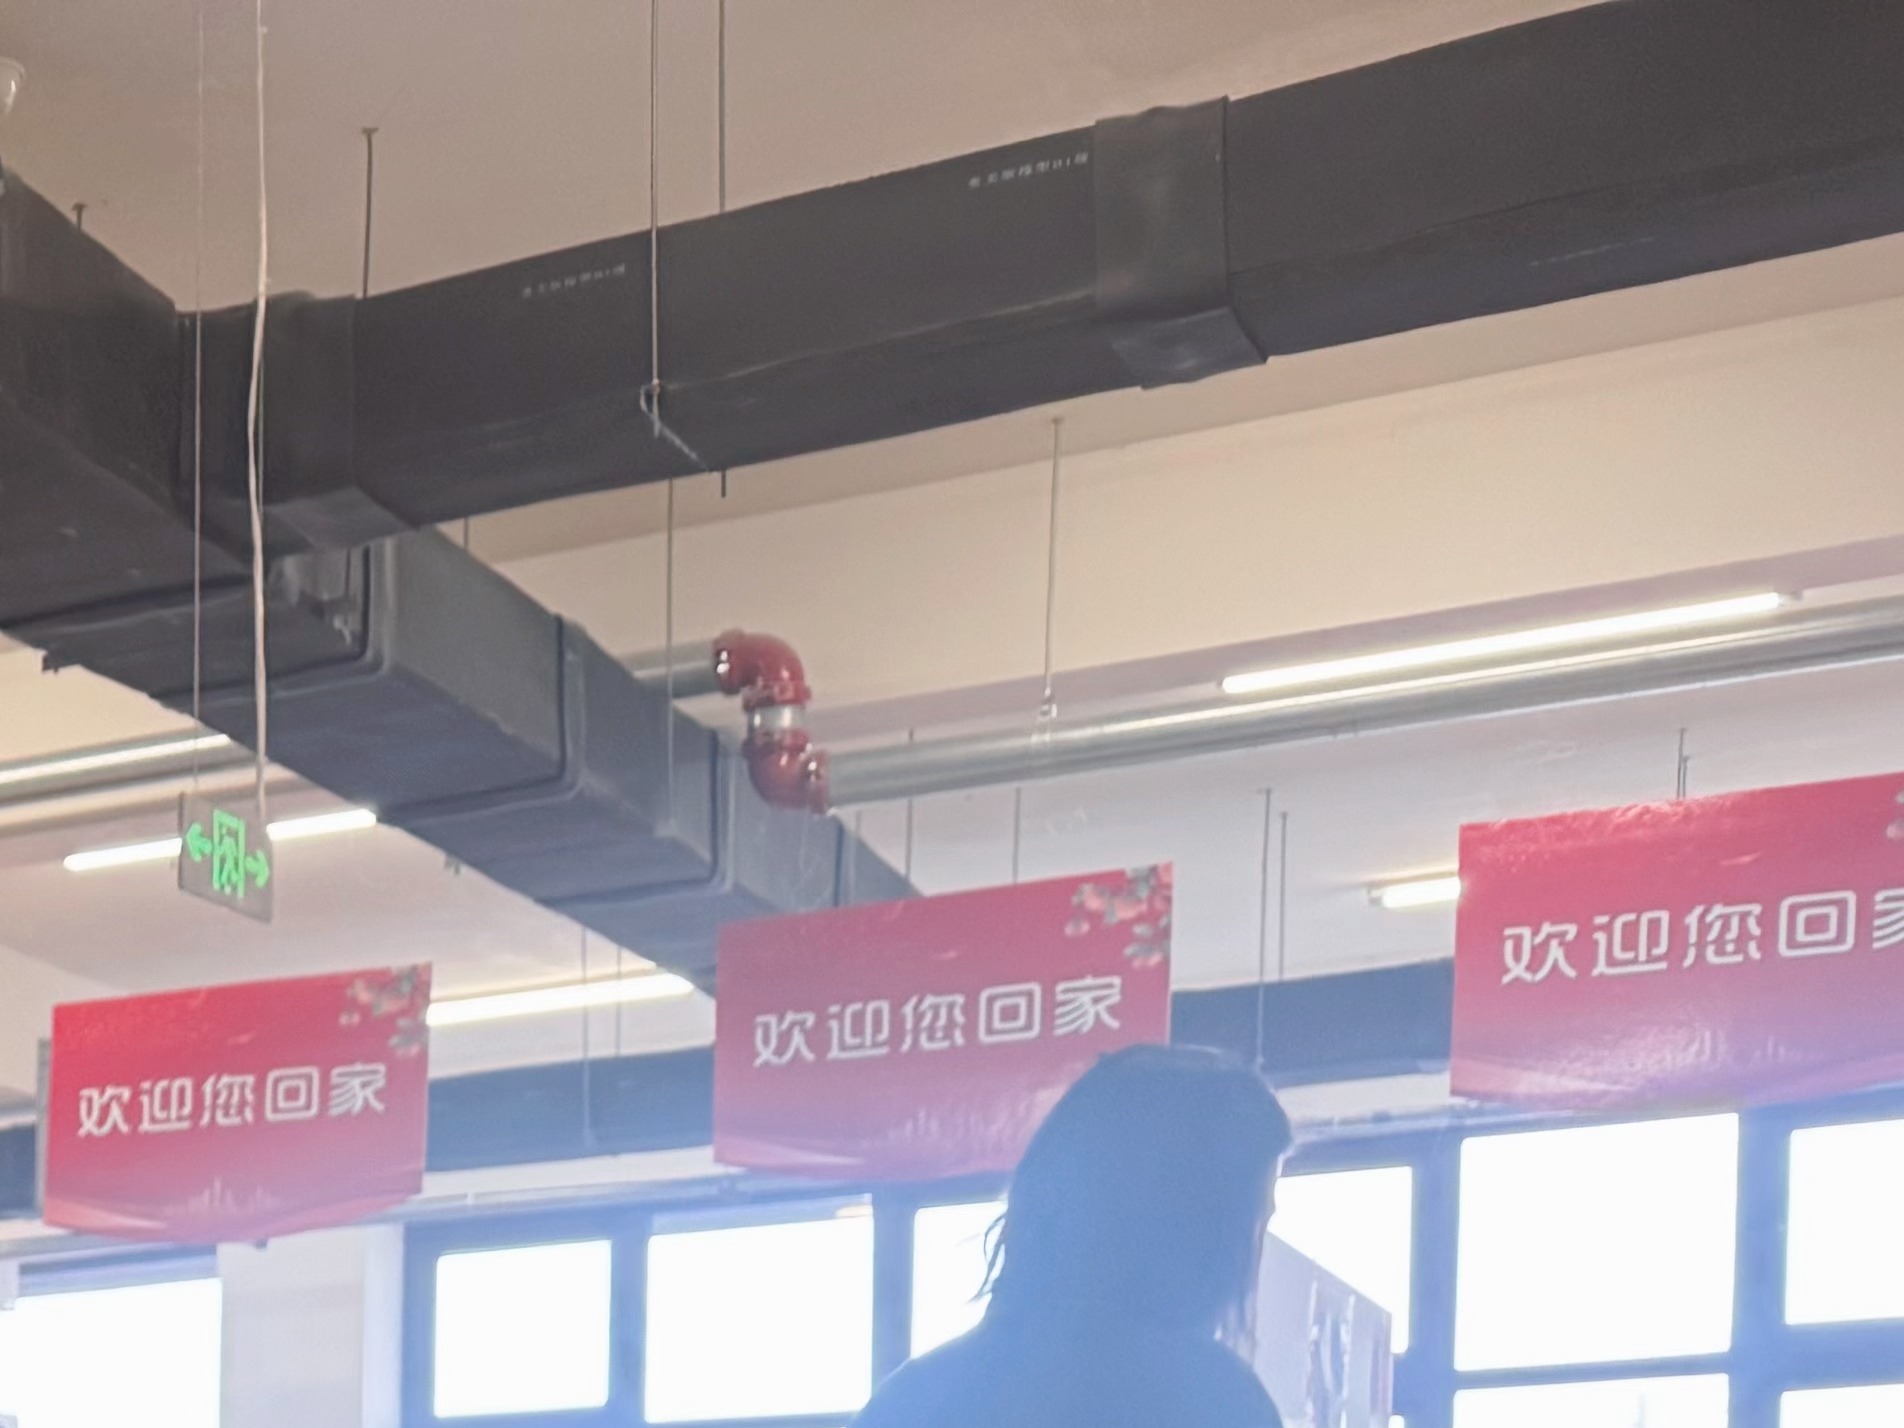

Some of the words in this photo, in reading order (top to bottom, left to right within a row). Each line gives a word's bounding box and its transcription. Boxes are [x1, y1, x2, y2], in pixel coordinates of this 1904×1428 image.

[753, 975, 1122, 1068] 欢迎您回家
[77, 1061, 387, 1138] 欢迎您回家
